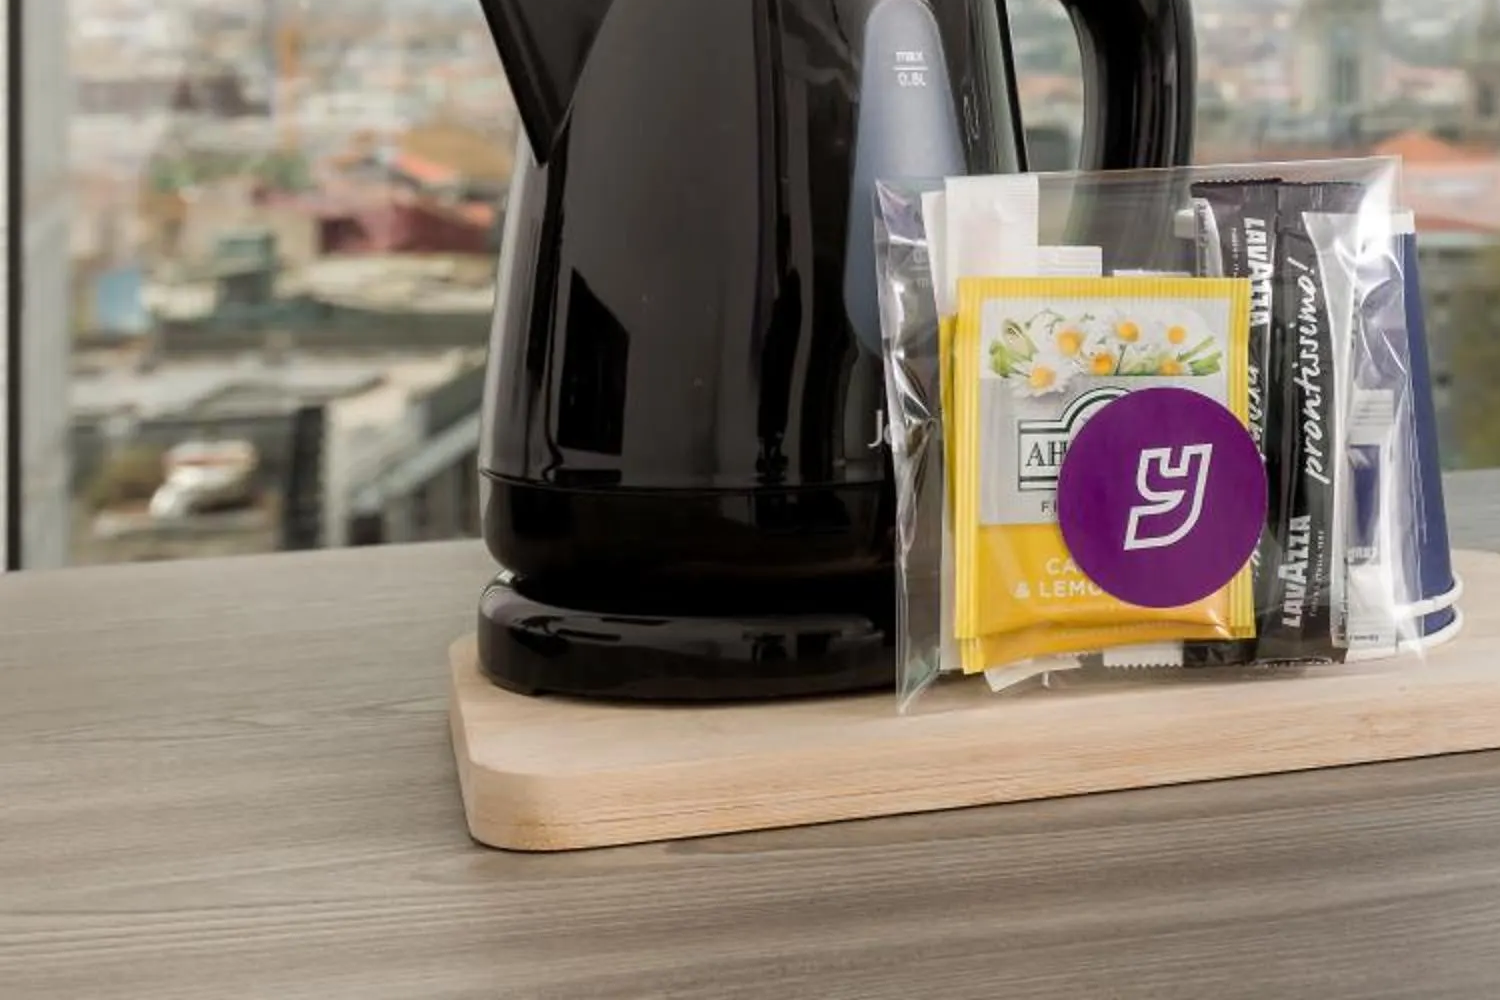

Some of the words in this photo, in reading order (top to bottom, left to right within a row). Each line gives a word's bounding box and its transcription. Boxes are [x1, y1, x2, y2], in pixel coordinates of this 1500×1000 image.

[1243, 217, 1275, 327] LAVAZZA
[1286, 256, 1331, 485] prontissimo!
[1277, 514, 1312, 628] LAVAZZA
